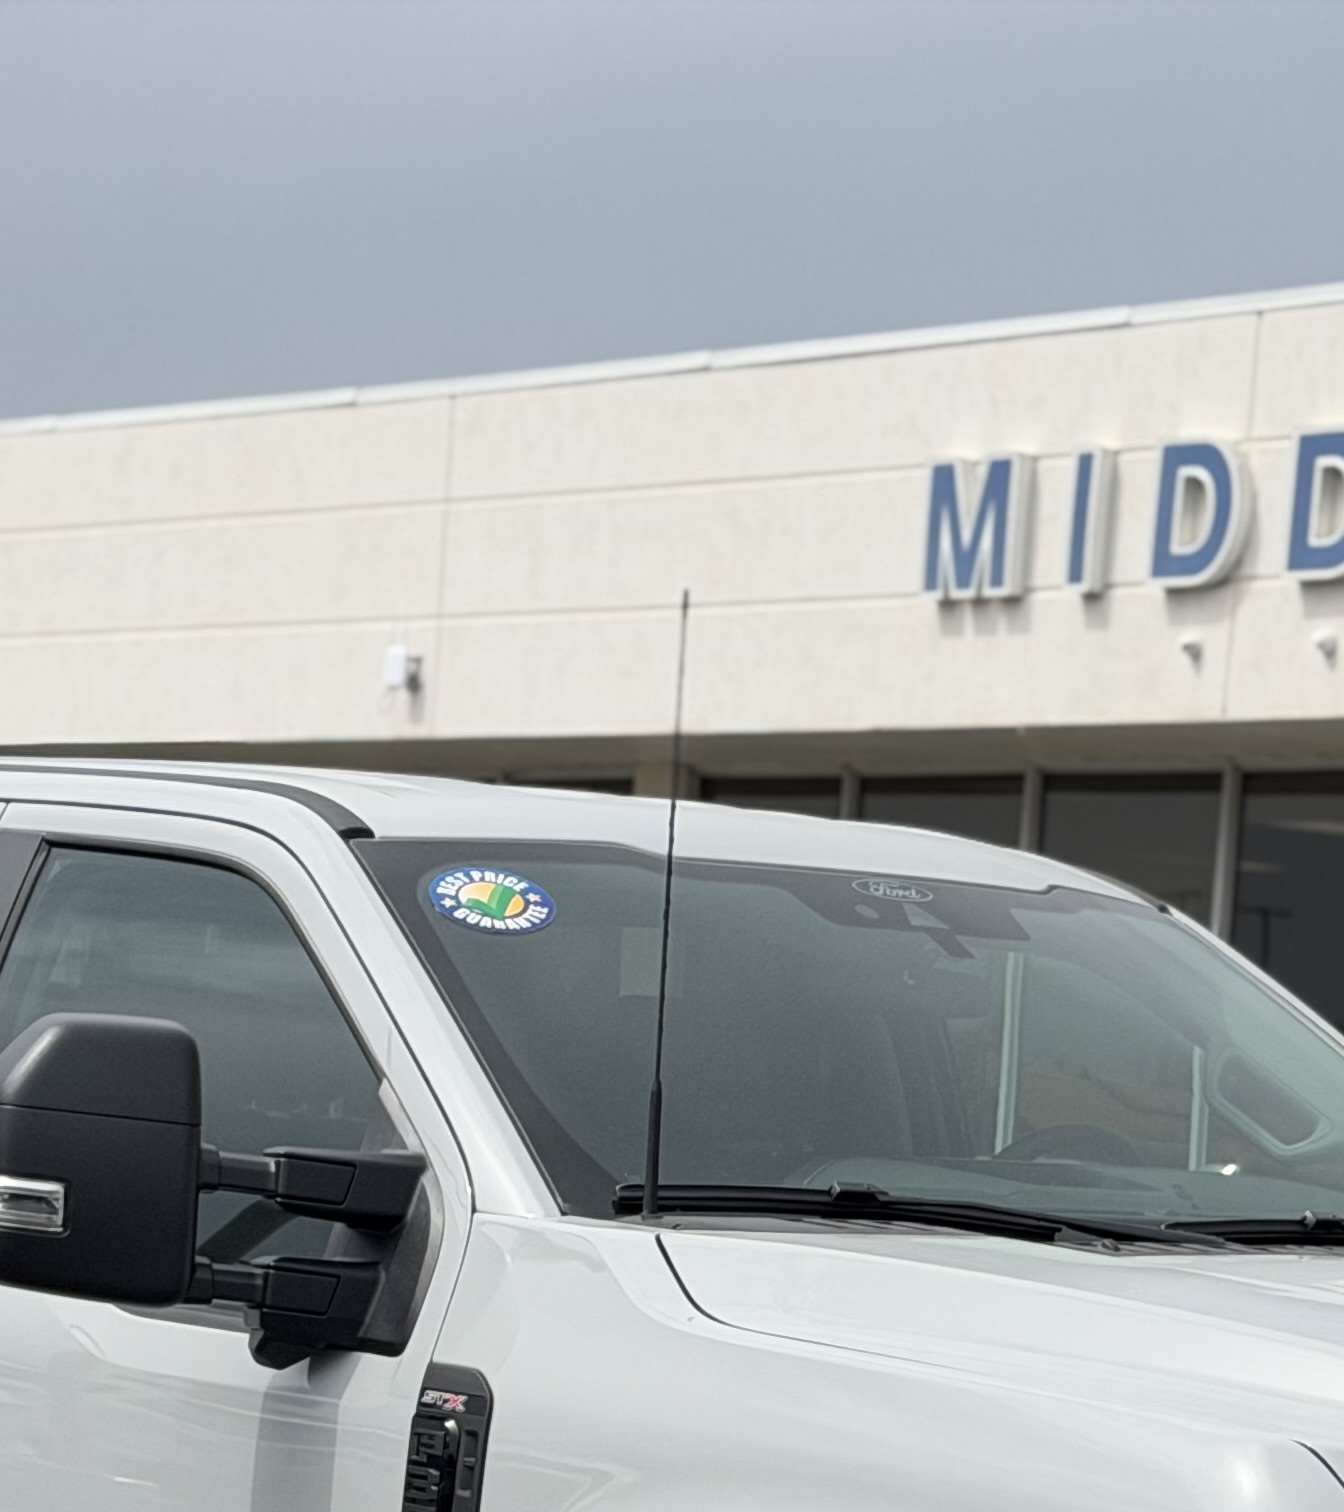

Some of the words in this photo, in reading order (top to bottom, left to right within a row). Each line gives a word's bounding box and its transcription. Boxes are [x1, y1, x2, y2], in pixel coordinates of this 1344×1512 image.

[436, 871, 471, 897] BEST
[470, 870, 530, 893] PRICE
[868, 879, 922, 899] Ford
[452, 903, 549, 931] GUARANTEE
[420, 1389, 469, 1412] STX
